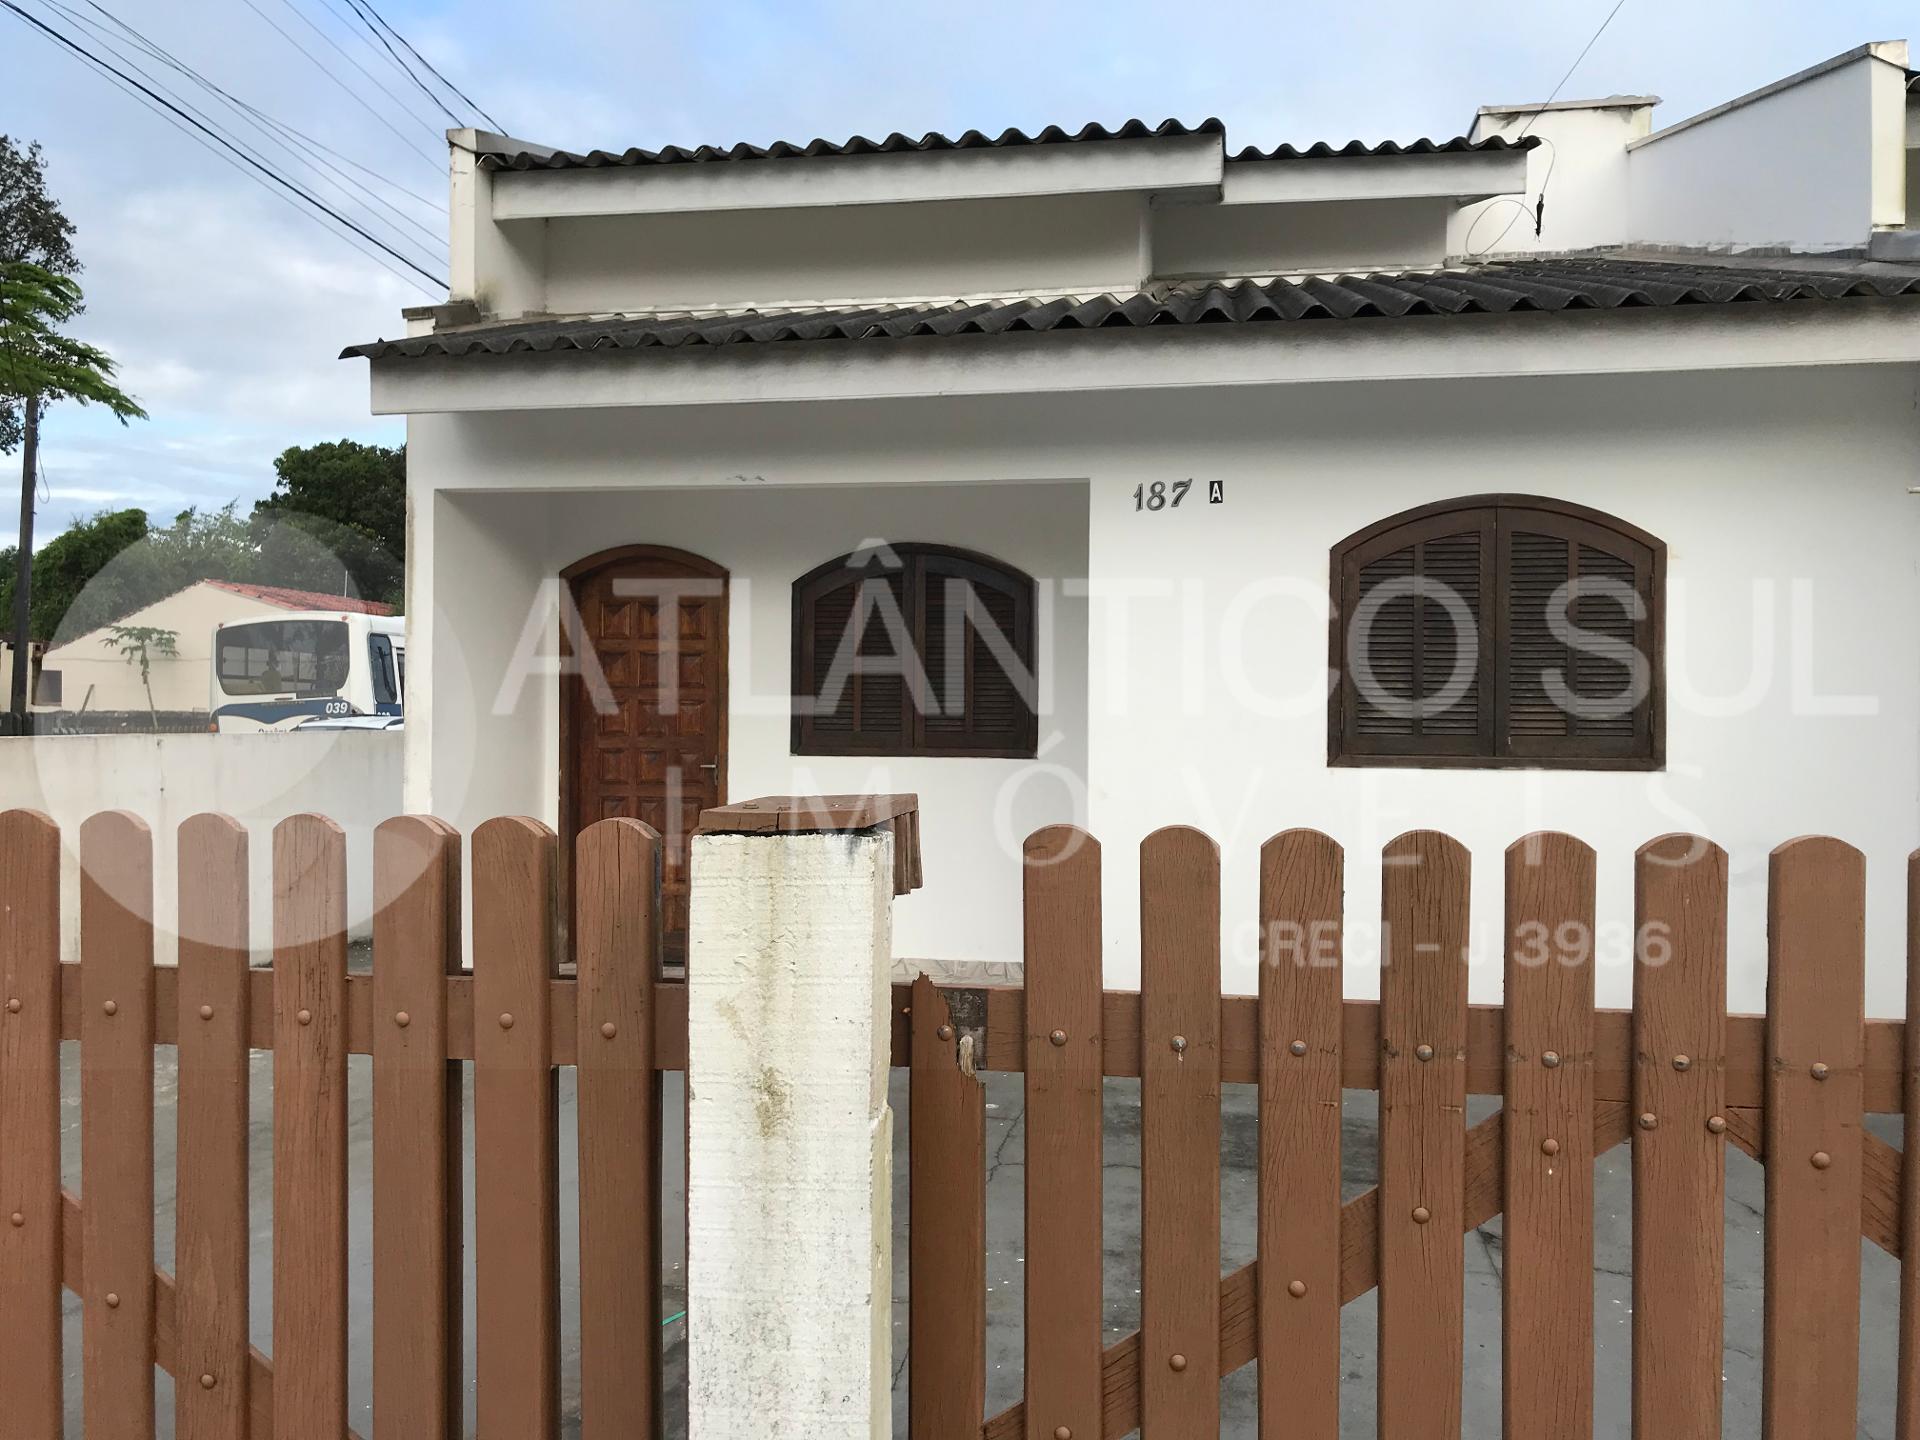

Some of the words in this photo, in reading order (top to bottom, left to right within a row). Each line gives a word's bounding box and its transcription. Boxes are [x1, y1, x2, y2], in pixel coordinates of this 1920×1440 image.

[1133, 478, 1193, 512] 187
[1210, 481, 1223, 502] A
[325, 702, 348, 714] 039
